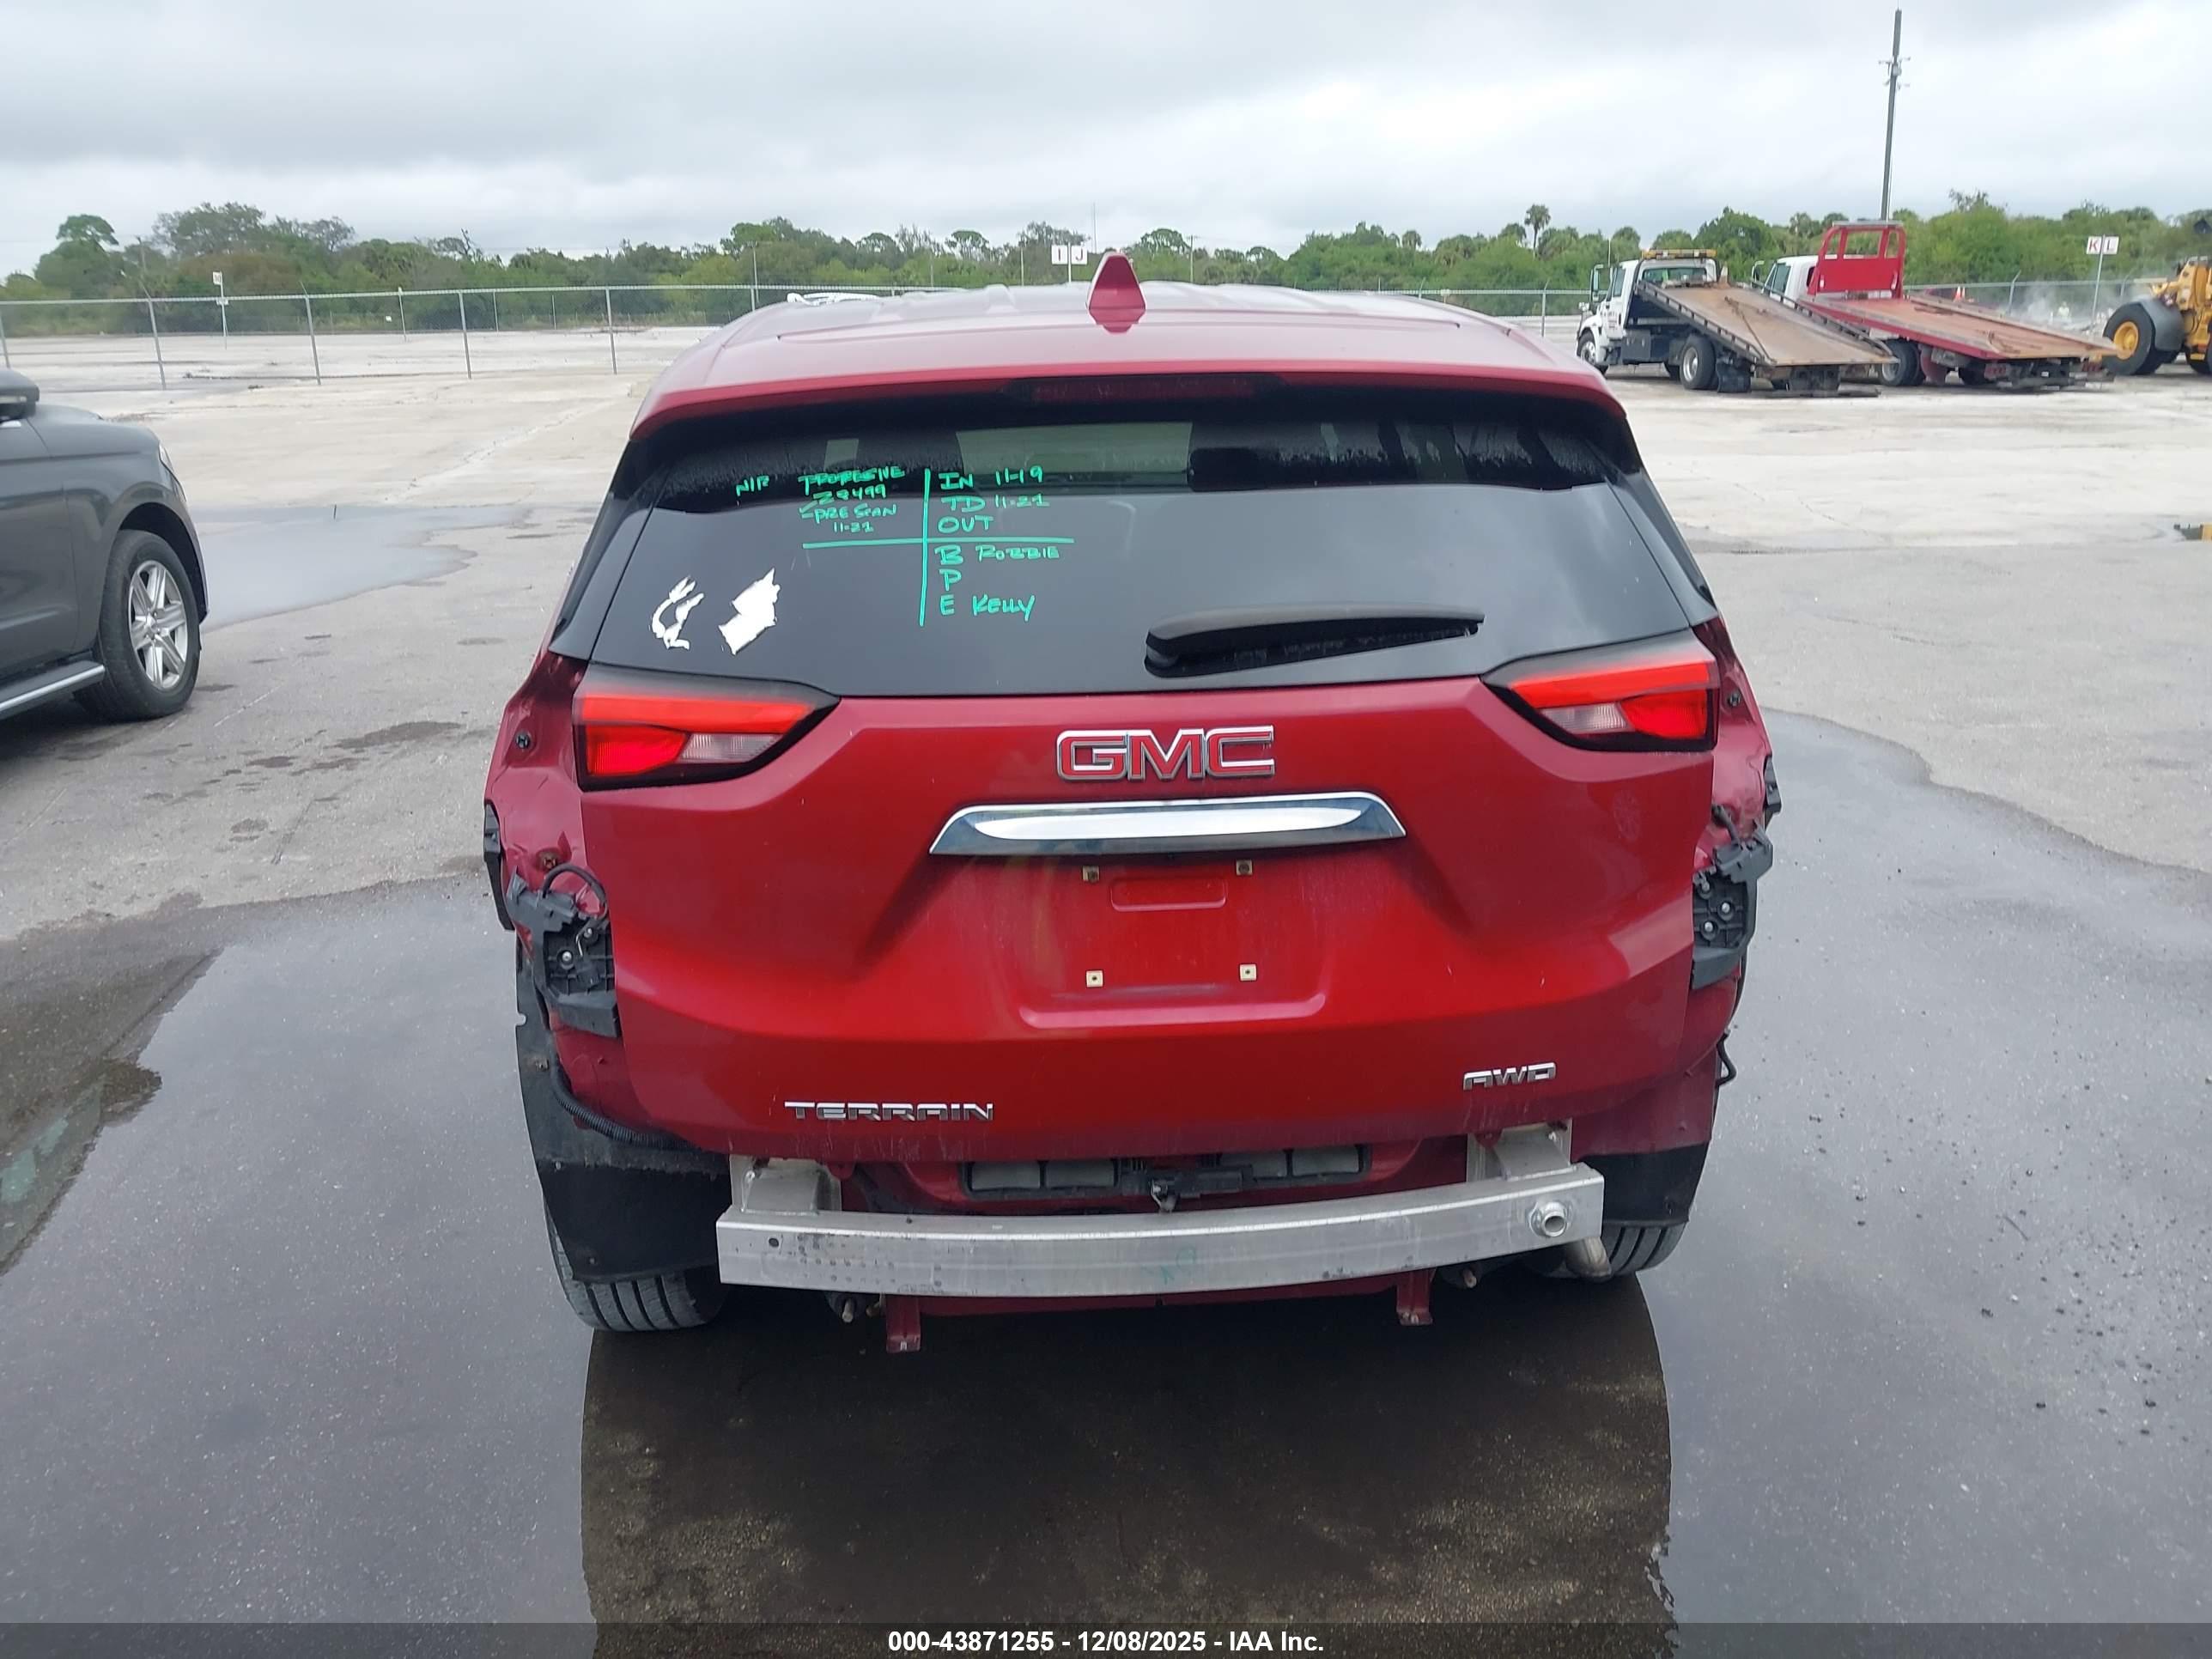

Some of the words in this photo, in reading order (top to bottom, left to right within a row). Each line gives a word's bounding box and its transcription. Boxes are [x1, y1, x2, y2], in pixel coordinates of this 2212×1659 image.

[938, 472, 974, 489] IN
[995, 465, 1042, 485] 11-19
[994, 494, 1050, 508] 11-21
[938, 515, 994, 533] OUT
[934, 544, 963, 565] B
[939, 568, 962, 591] P
[940, 594, 955, 616] E
[1056, 725, 1275, 781] GMC
[1463, 1061, 1556, 1091] AWD
[784, 1101, 994, 1121] TERRAIN
